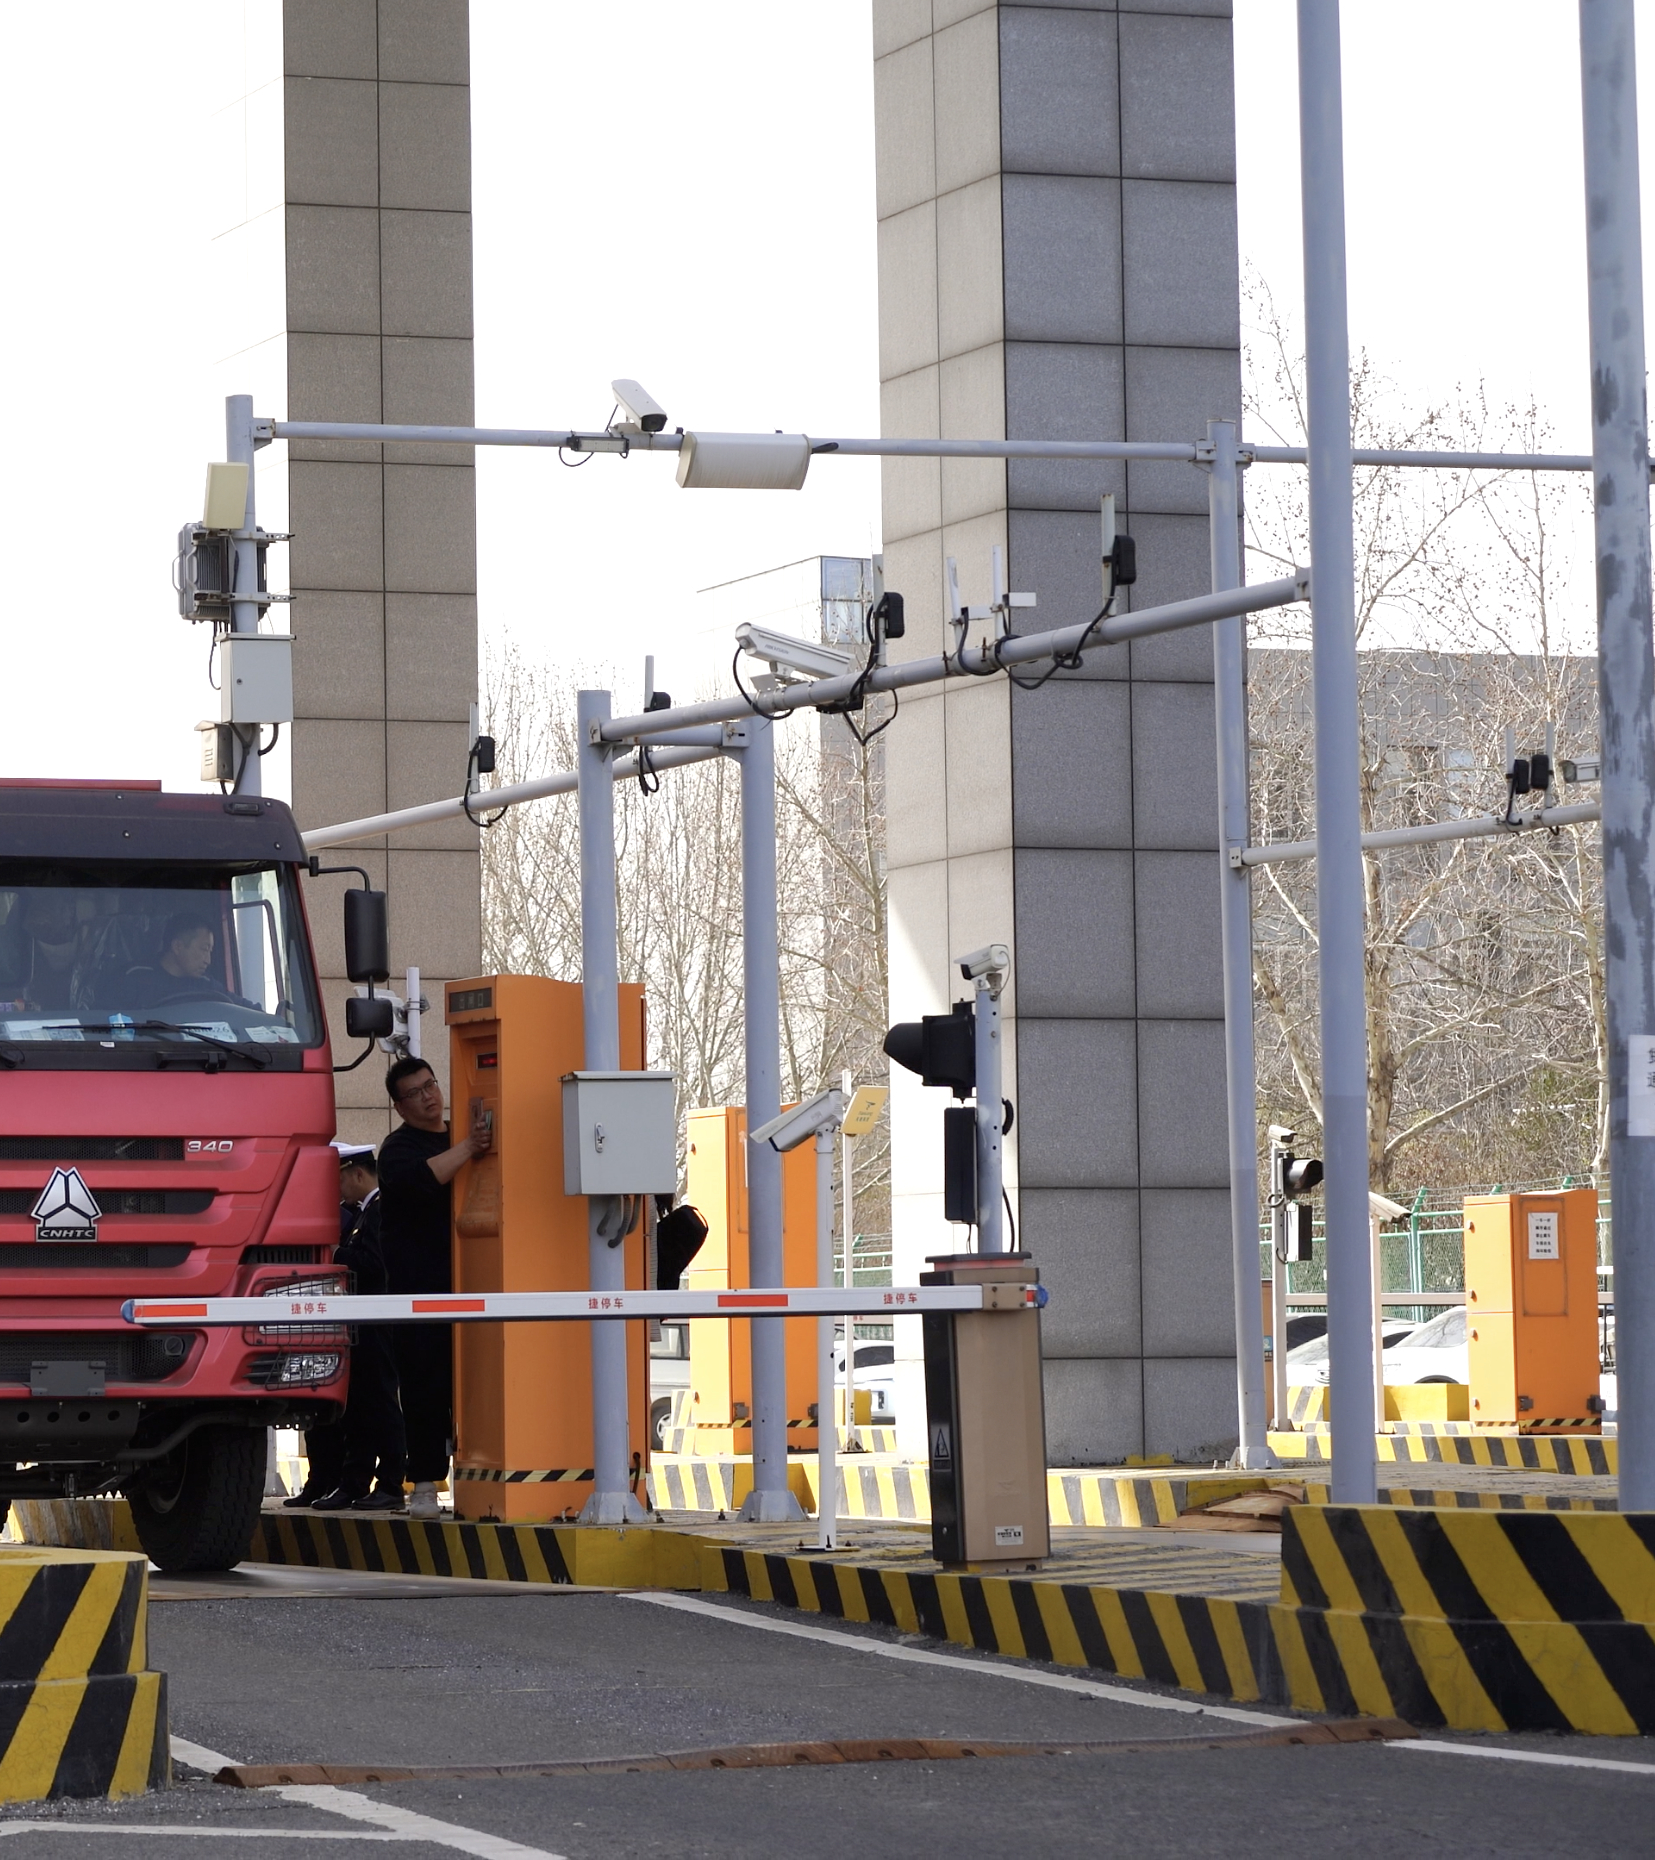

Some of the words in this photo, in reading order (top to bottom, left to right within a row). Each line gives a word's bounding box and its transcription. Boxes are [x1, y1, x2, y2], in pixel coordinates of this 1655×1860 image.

[187, 1140, 233, 1152] 340
[39, 1229, 94, 1238] CNHTC
[588, 1297, 624, 1309] 捷停车
[883, 1292, 918, 1305] 捷停车
[291, 1302, 327, 1315] 捷停车
